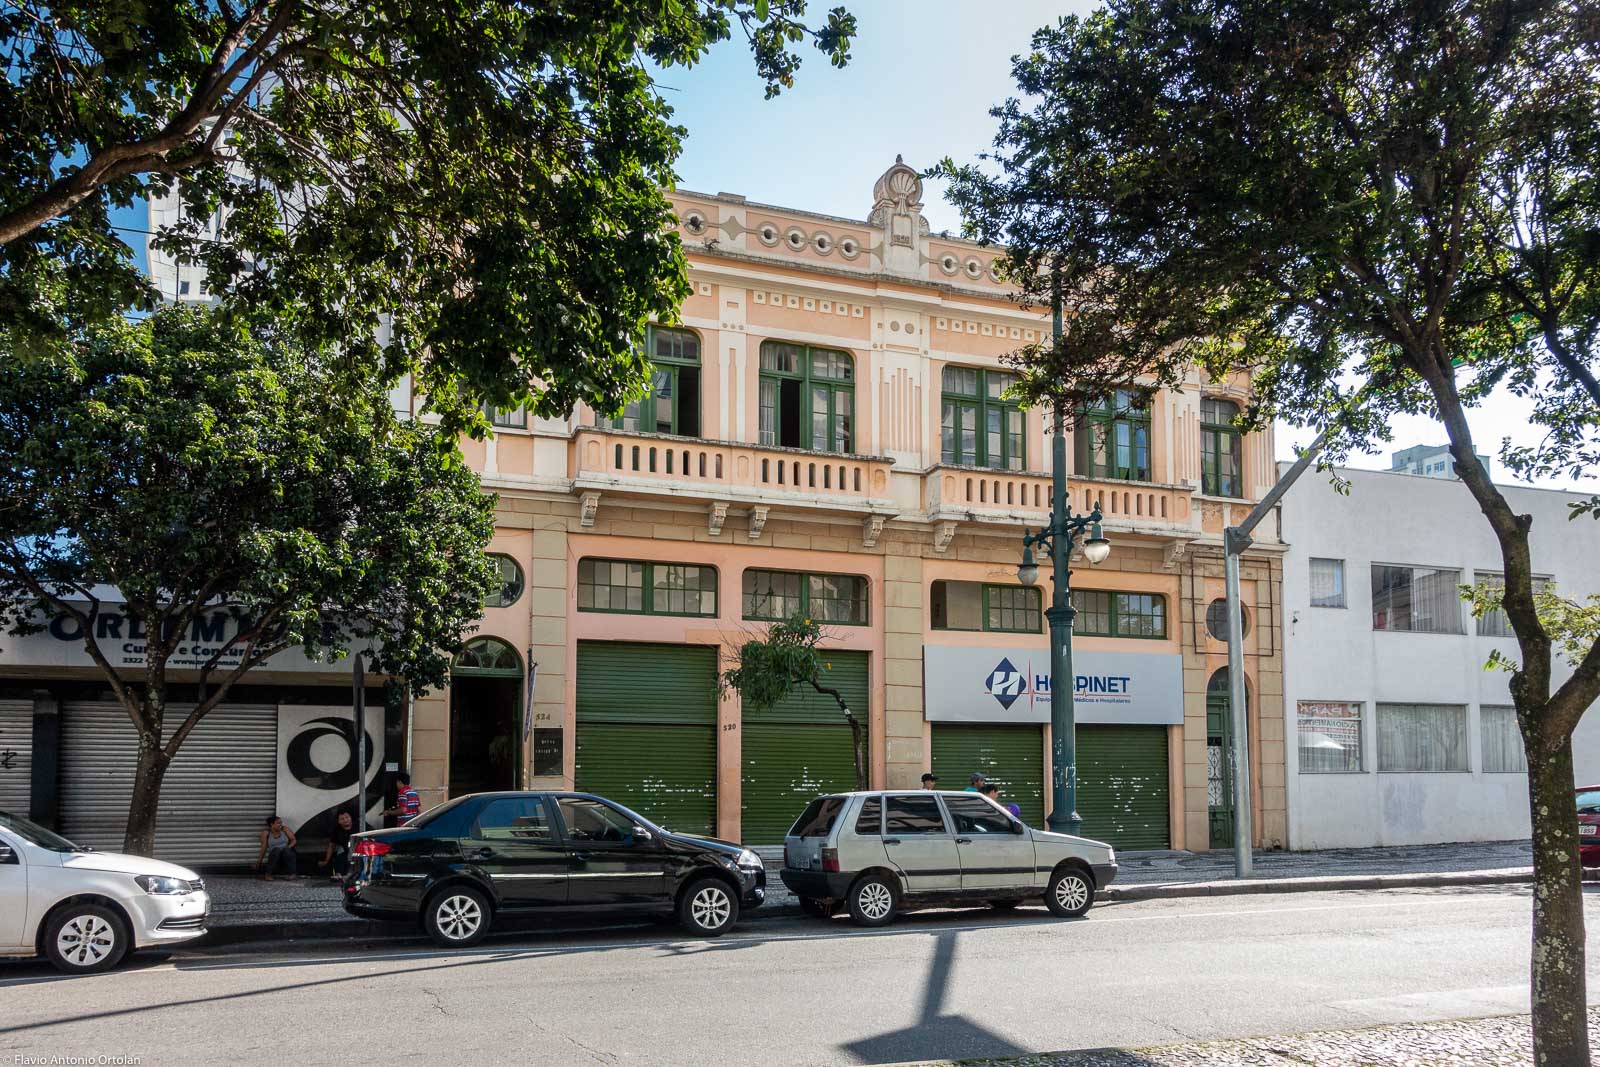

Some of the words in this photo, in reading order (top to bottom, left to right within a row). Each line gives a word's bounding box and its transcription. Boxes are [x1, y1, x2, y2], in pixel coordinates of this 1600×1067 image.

[1035, 674, 1130, 693] HPINET
[536, 713, 551, 721] 524
[723, 723, 737, 731] 520
